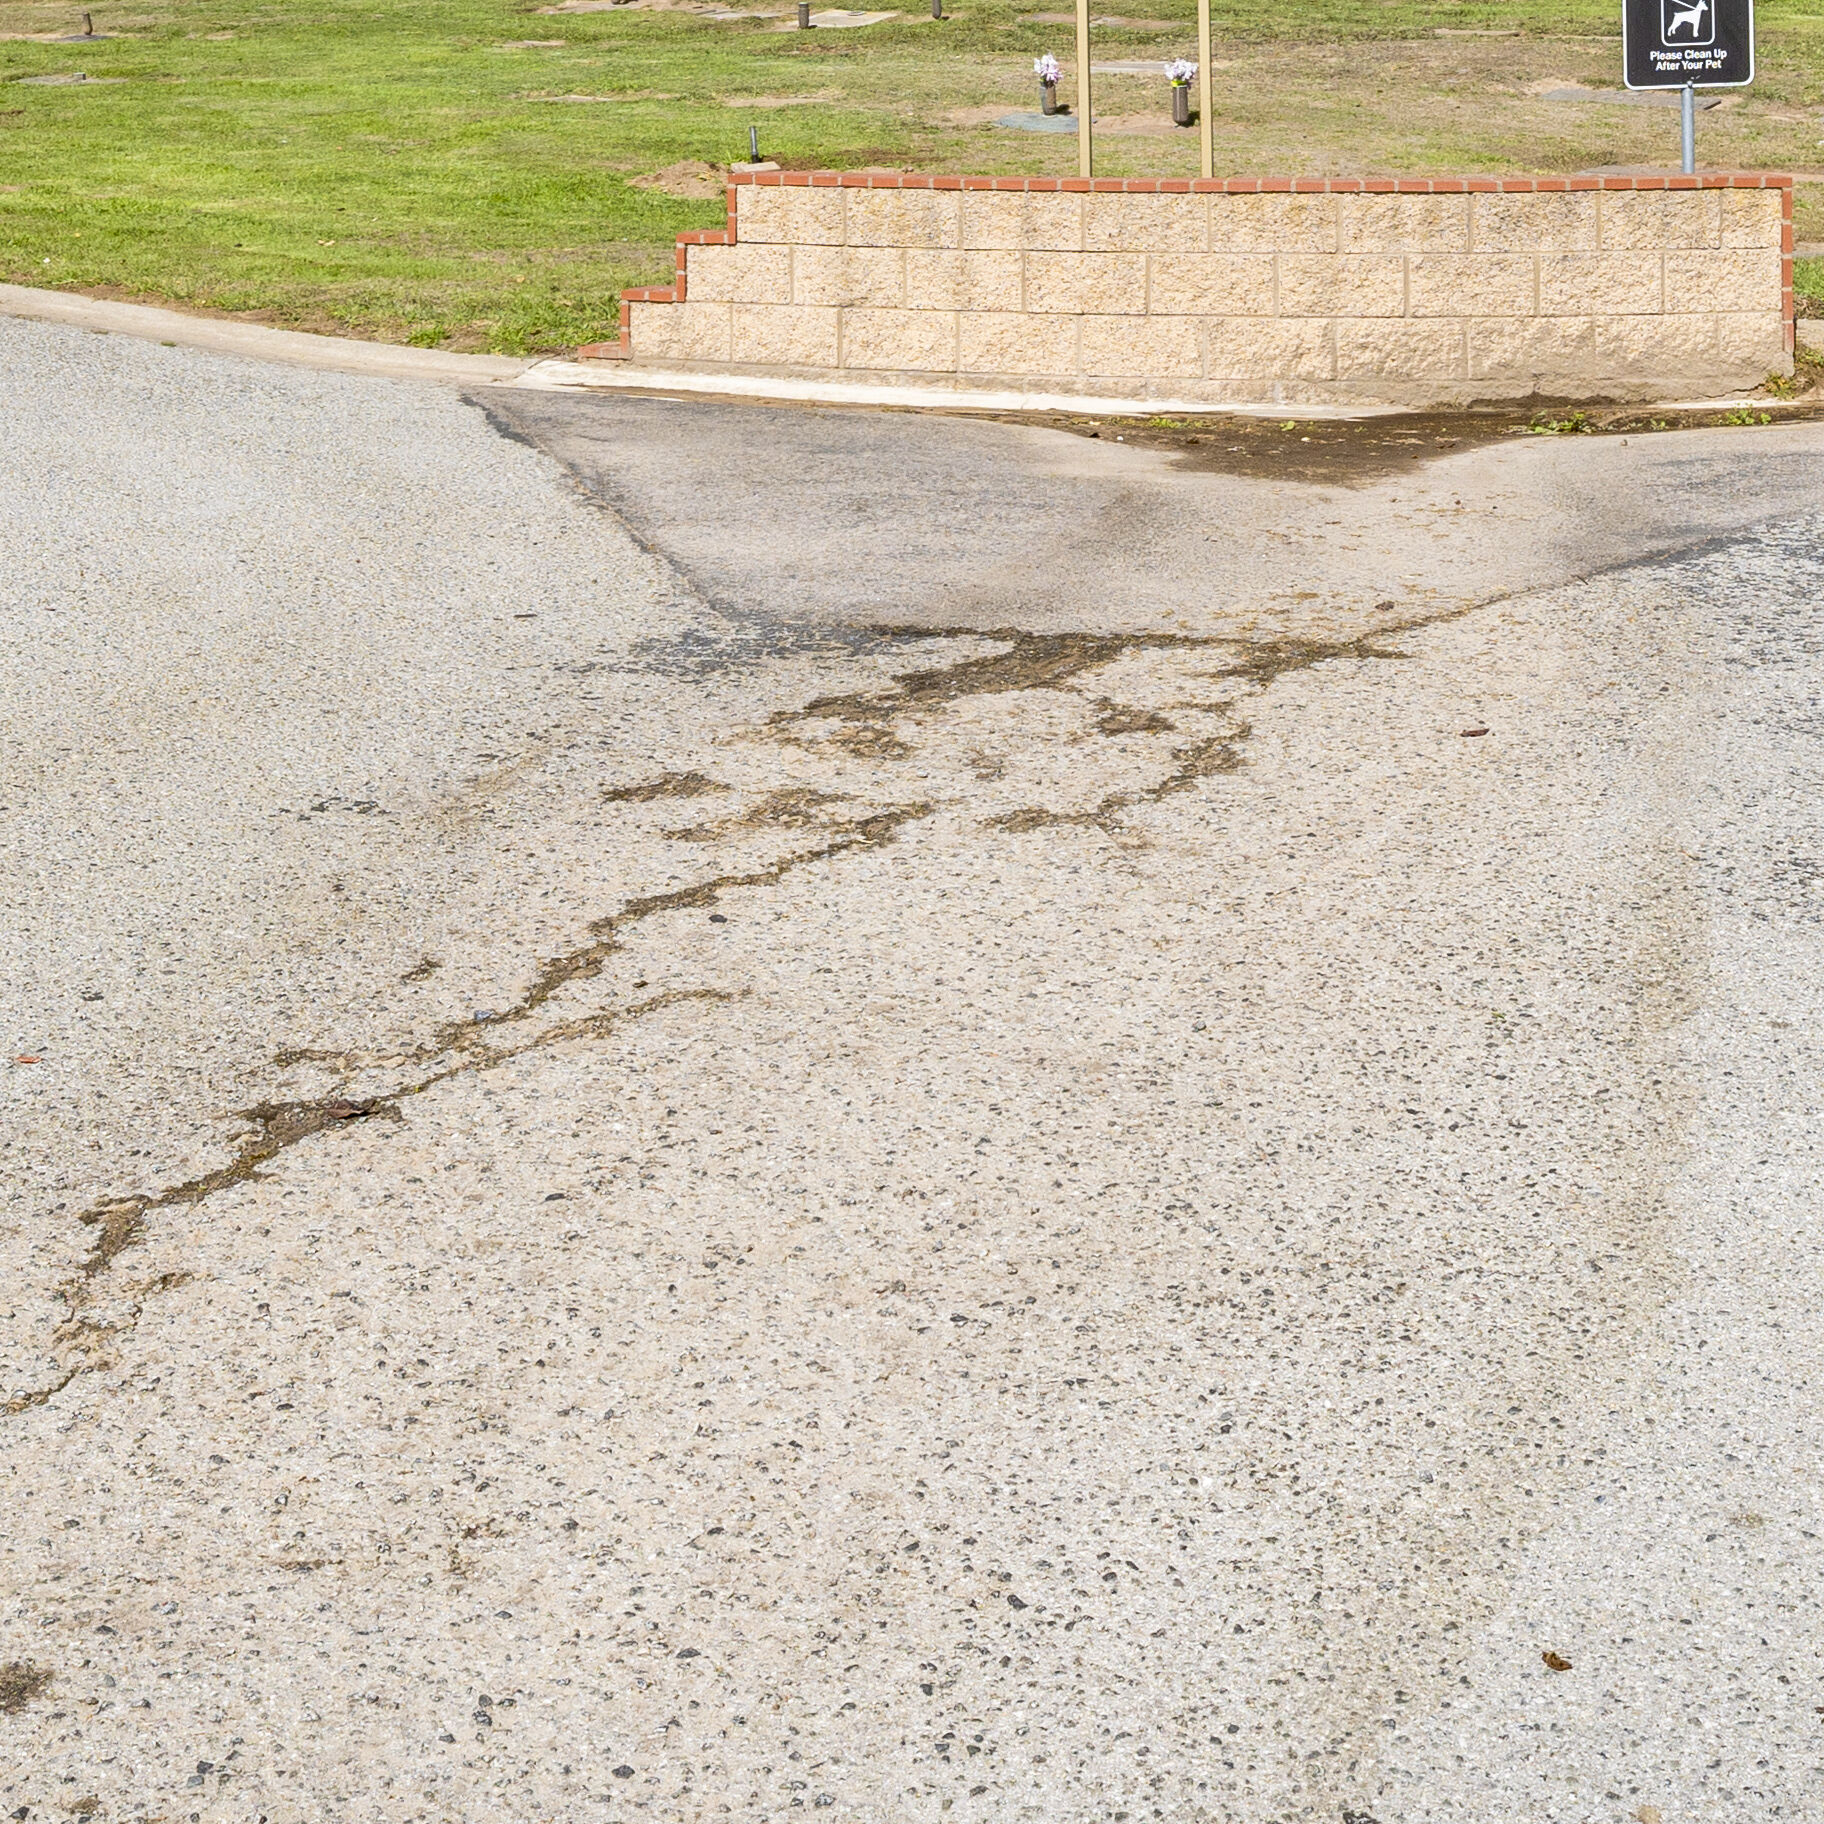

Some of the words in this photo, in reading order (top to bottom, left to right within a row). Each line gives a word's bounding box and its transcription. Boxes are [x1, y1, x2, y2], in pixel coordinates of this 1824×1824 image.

[1649, 50, 1683, 61] Please
[1684, 49, 1712, 59] Clean
[1713, 48, 1728, 60] Up
[1655, 61, 1681, 71] After
[1681, 60, 1704, 70] Your
[1705, 59, 1722, 69] Pet
